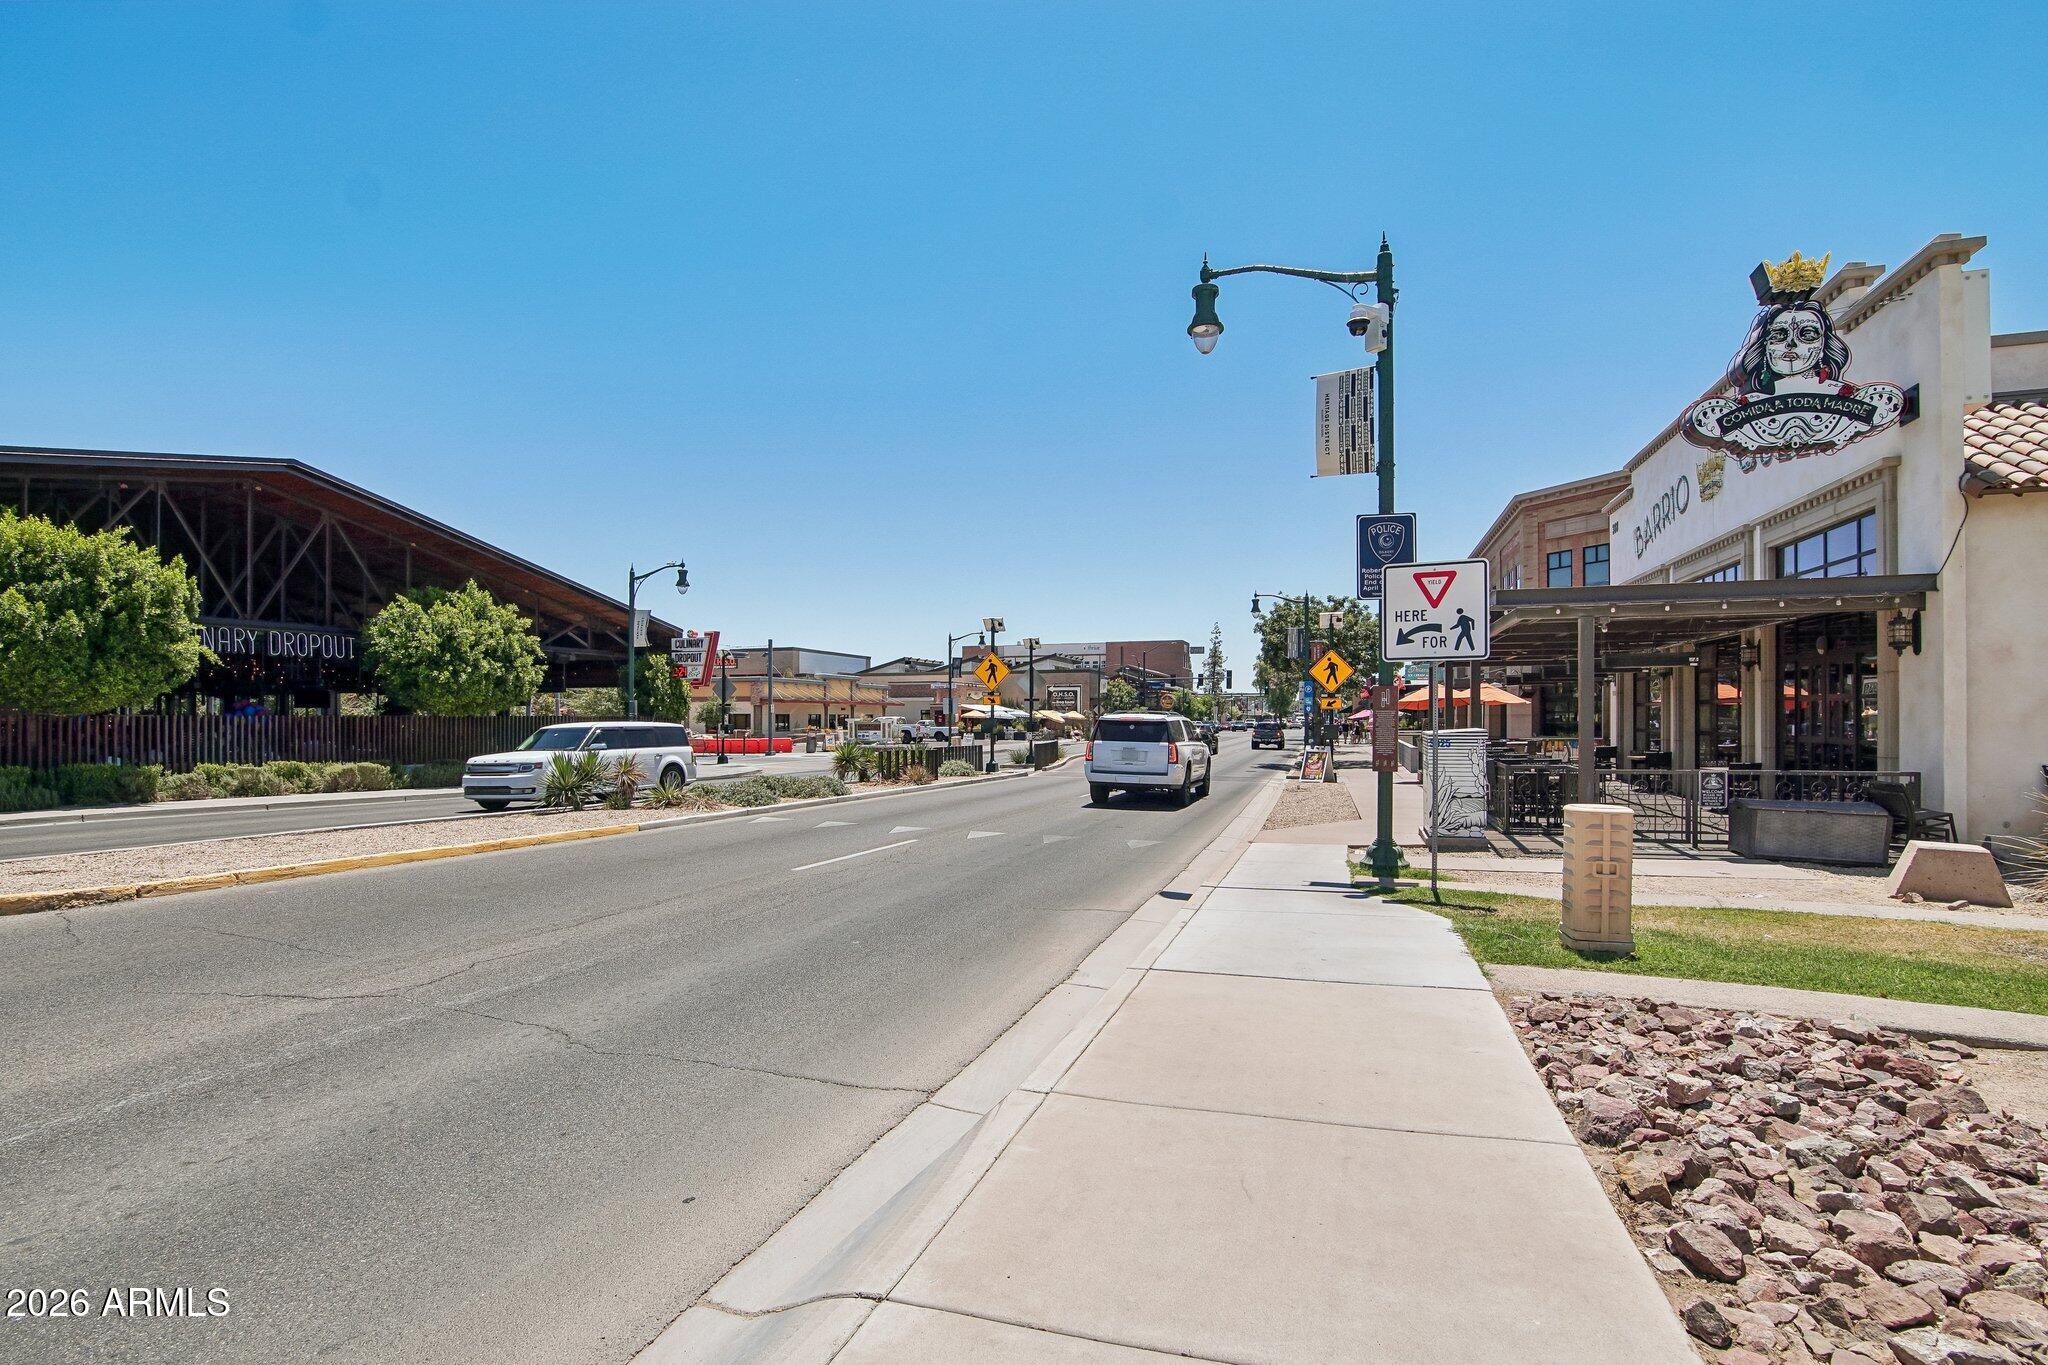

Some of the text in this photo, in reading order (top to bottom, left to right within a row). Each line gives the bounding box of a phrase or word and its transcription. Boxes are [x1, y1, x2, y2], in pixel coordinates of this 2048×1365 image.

[1723, 404, 1773, 426] COMIDA
[1786, 398, 1822, 411] TODA
[1823, 398, 1871, 417] MADRE
[1634, 475, 1690, 560] BARRIO
[1371, 525, 1402, 536] POLICE
[1395, 610, 1428, 622] HERE
[269, 631, 356, 659] DROPOUT
[674, 640, 704, 648] CULINARY
[1422, 636, 1447, 648] FOR
[674, 653, 702, 662] DROPOUT
